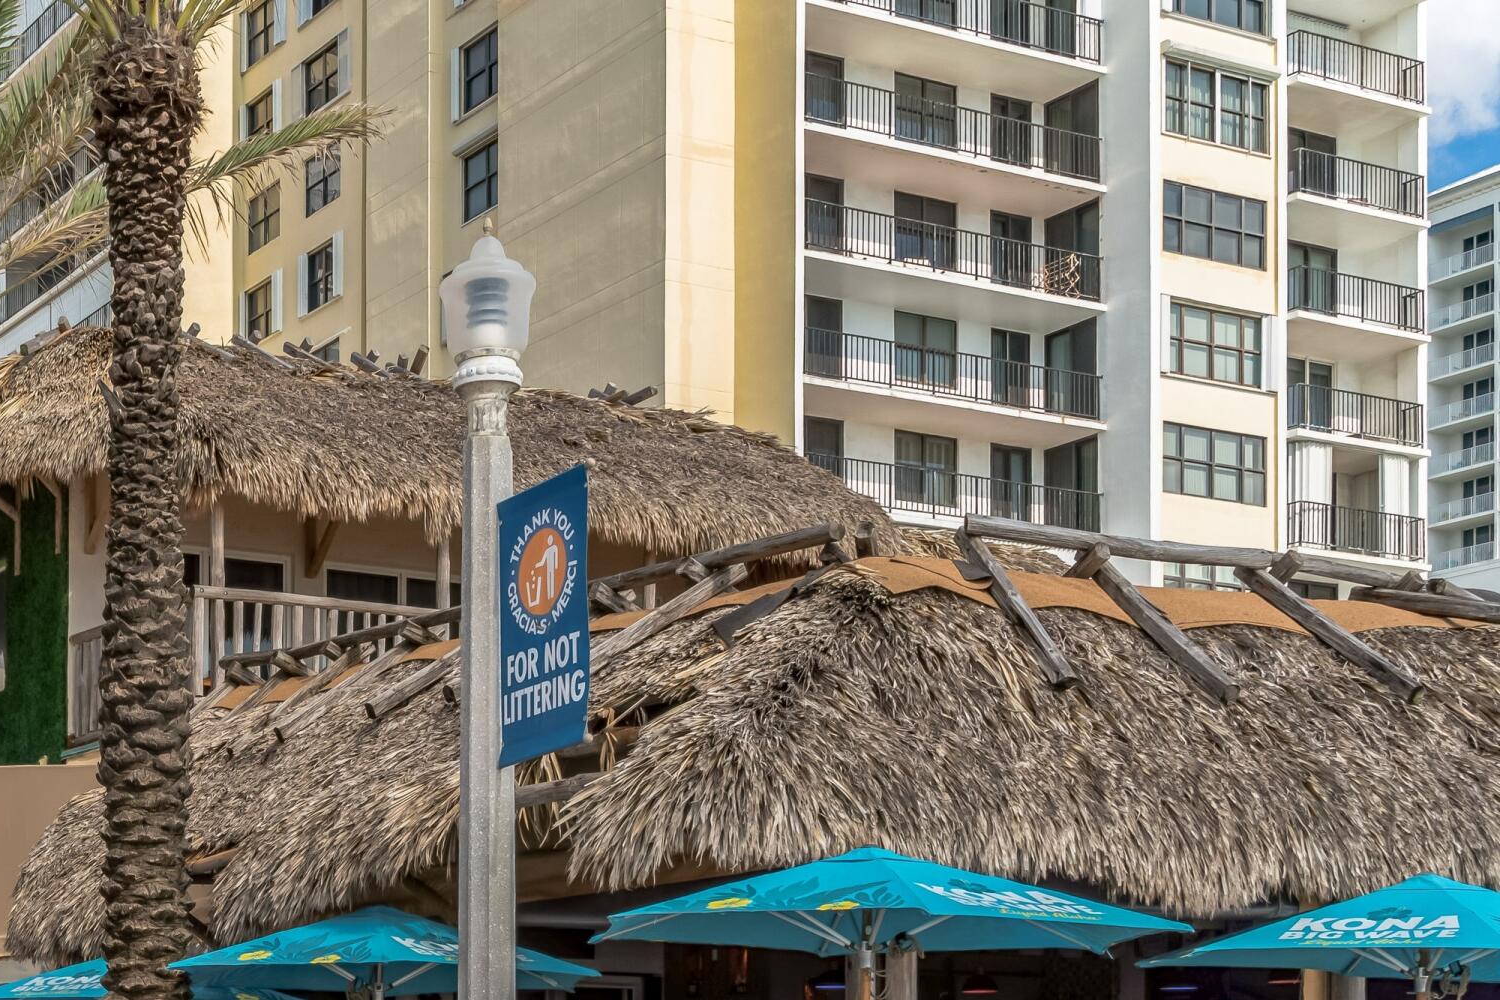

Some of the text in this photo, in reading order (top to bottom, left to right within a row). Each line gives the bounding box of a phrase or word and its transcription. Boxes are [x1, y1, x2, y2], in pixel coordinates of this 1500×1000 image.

[510, 508, 575, 563] THANK YOU
[507, 559, 578, 635] GRACIAS MERCI
[507, 631, 581, 687] FOR NOT
[503, 669, 586, 726] LITTERING
[914, 882, 1076, 904] KONA
[1289, 915, 1460, 931] KONA
[391, 936, 459, 951] KO
[1278, 930, 1460, 940] BIG WAVE
[21, 974, 101, 988] KON
